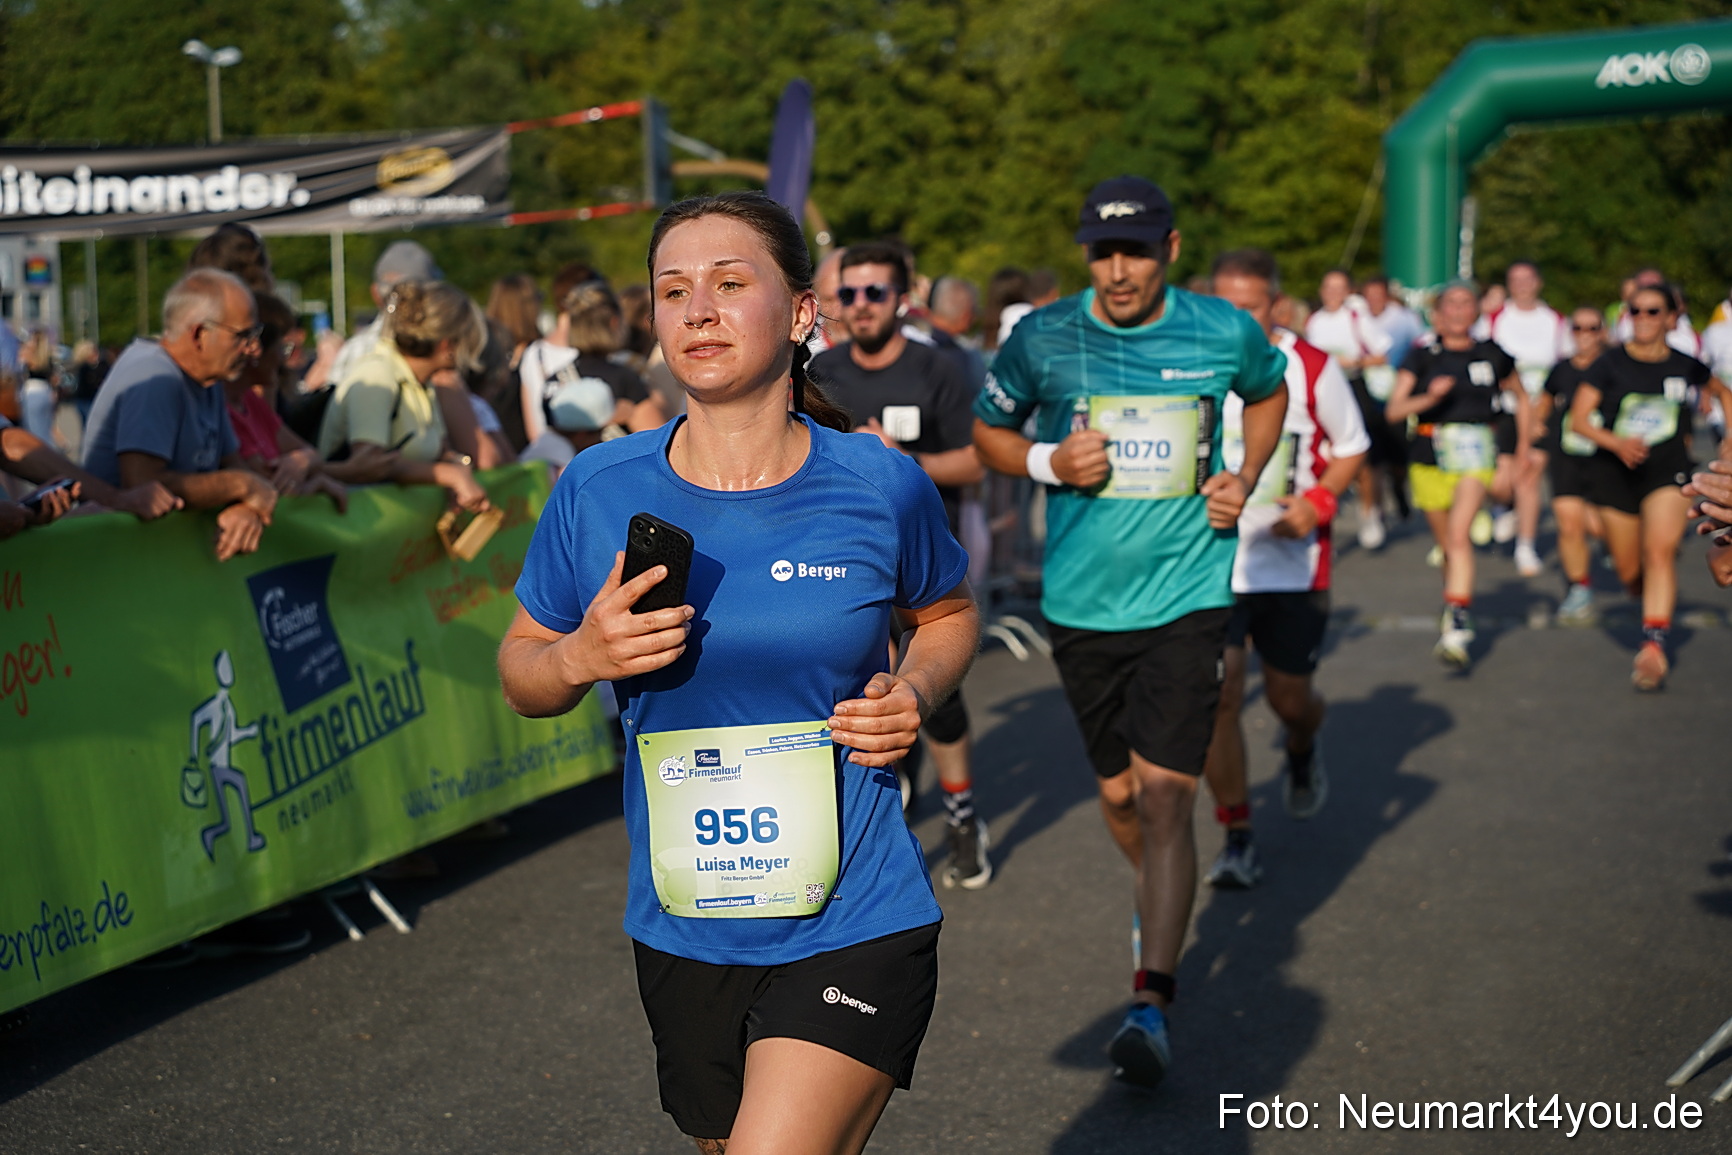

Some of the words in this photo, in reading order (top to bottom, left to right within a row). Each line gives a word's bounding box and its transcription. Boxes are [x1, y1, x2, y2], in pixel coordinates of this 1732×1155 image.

[1595, 51, 1672, 89] AOK
[0, 164, 311, 215] iteinander.
[1114, 440, 1171, 459] 1070
[798, 562, 847, 581] Berger
[0, 613, 72, 718] ger!
[260, 637, 426, 799] firmenlauf
[688, 763, 742, 778] Firmenlauf
[709, 774, 742, 783] neumarkt
[694, 806, 780, 845] 956
[696, 857, 737, 872] Luisa
[740, 856, 790, 873] Meyer
[698, 898, 752, 908] firmenlauf.bayern
[841, 993, 877, 1015] benger
